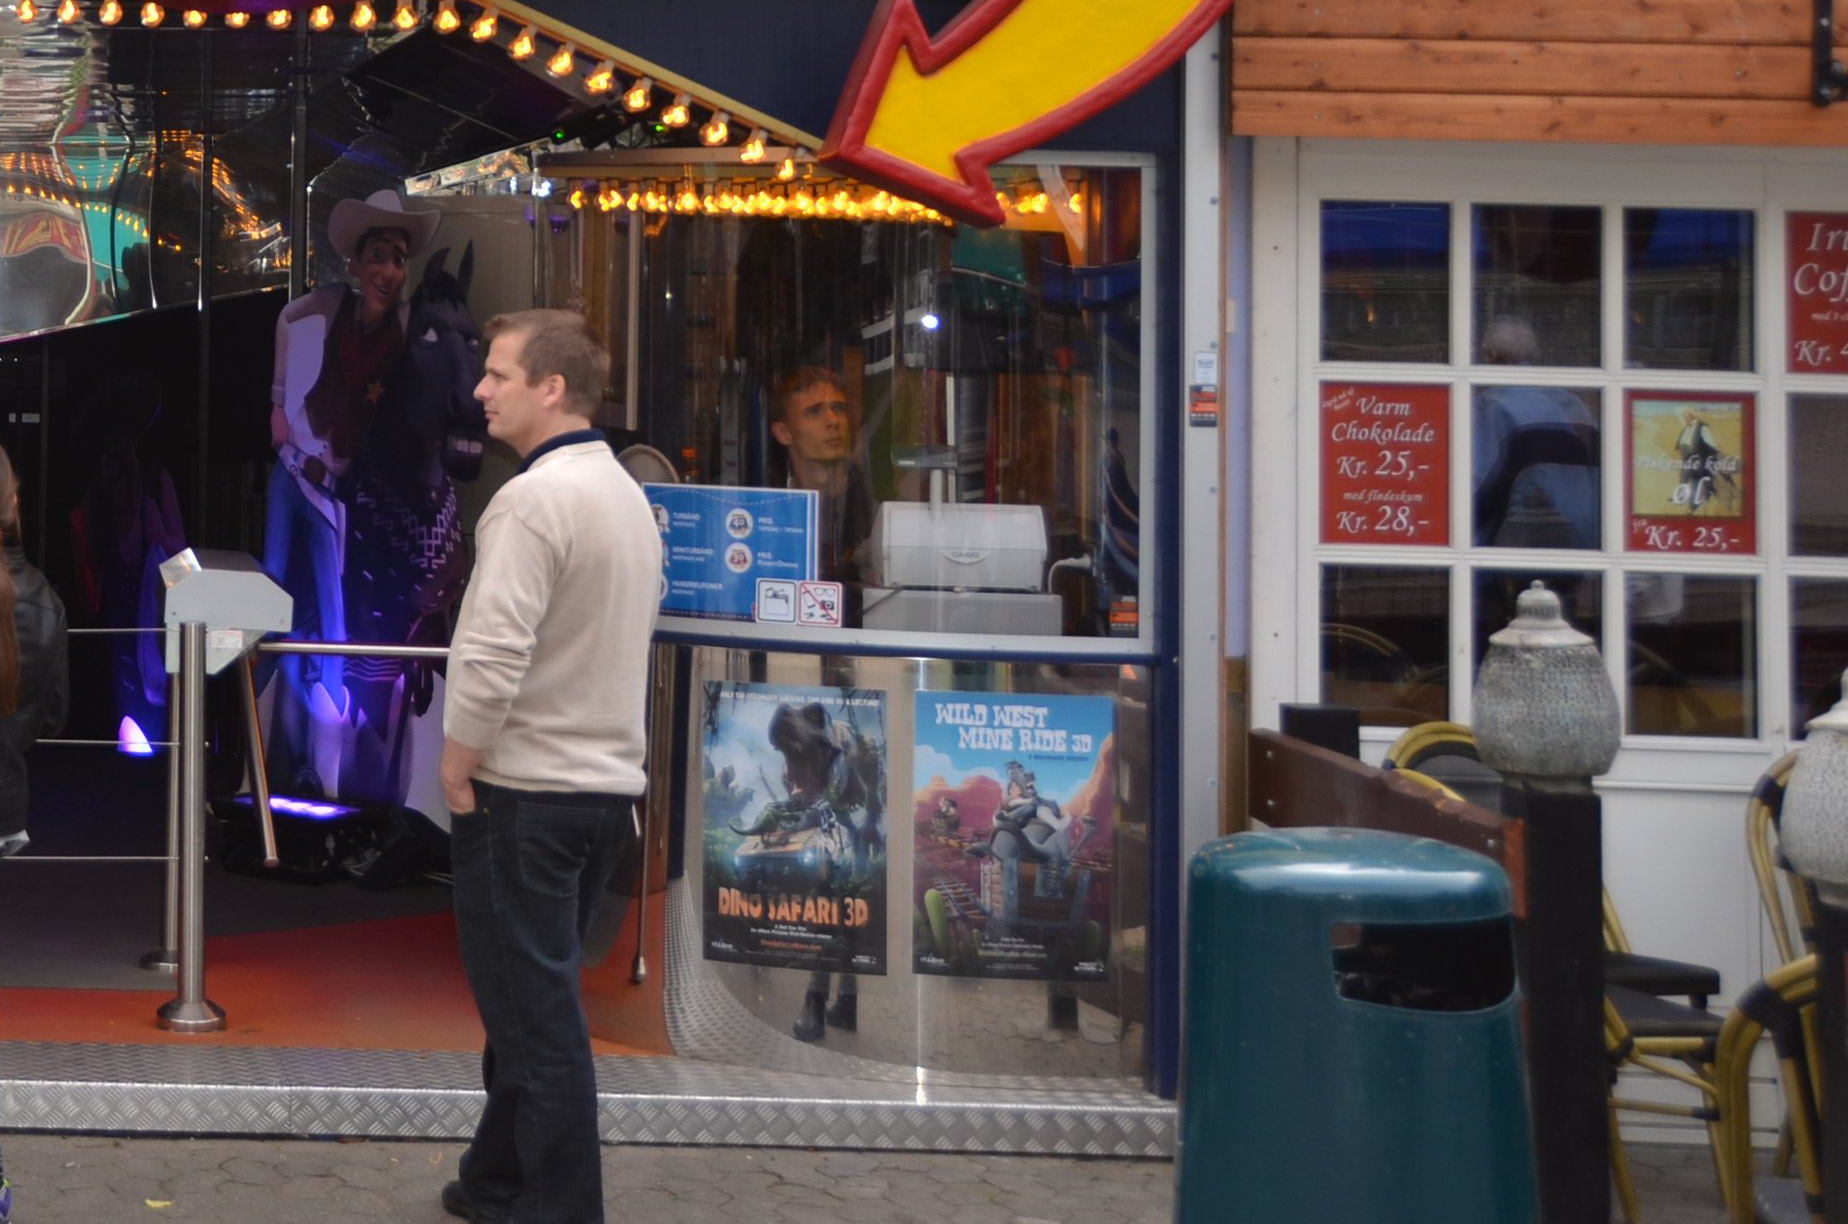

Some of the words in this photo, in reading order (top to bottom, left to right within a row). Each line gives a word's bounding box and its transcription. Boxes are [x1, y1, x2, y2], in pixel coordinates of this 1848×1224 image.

[1794, 340, 1832, 366] Kr.
[1356, 396, 1411, 416] Varm
[1331, 420, 1435, 446] Chokolade
[1337, 456, 1367, 478] Kr.
[1374, 449, 1430, 481] 25,-
[1343, 489, 1364, 501] med
[1336, 511, 1367, 534] Kr.
[1374, 505, 1430, 537] 28,-
[1645, 525, 1682, 550] Kr.
[1692, 526, 1740, 551] 25,-
[935, 703, 988, 726] WILD
[993, 705, 1048, 728] WEST
[958, 726, 1014, 752] MINE
[1019, 729, 1067, 753] RIDE
[1071, 733, 1093, 753] 3D
[718, 886, 764, 918] DINO
[768, 893, 841, 925] SAFARI
[844, 896, 870, 927] 3D
